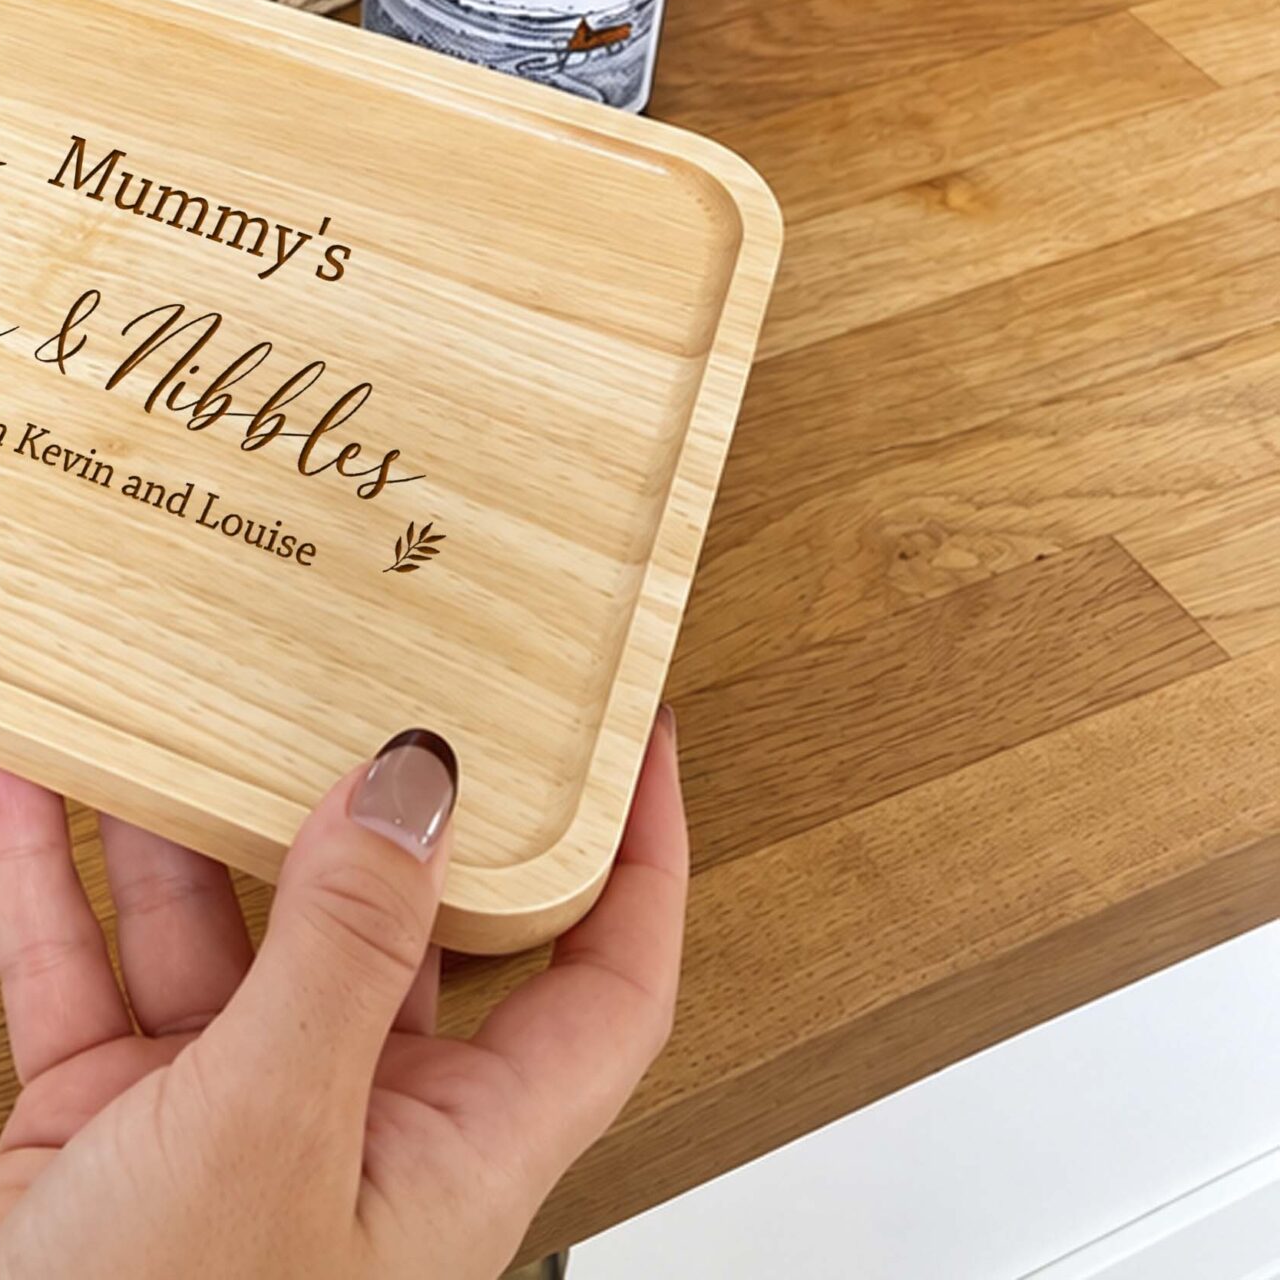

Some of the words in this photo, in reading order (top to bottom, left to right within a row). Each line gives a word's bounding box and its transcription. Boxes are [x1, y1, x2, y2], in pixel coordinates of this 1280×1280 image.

[47, 135, 352, 282] Mummy's
[35, 290, 101, 374] &
[105, 304, 425, 500] Nibbles
[13, 422, 114, 487] Kevin
[121, 474, 195, 518] and
[195, 493, 318, 567] Louise
